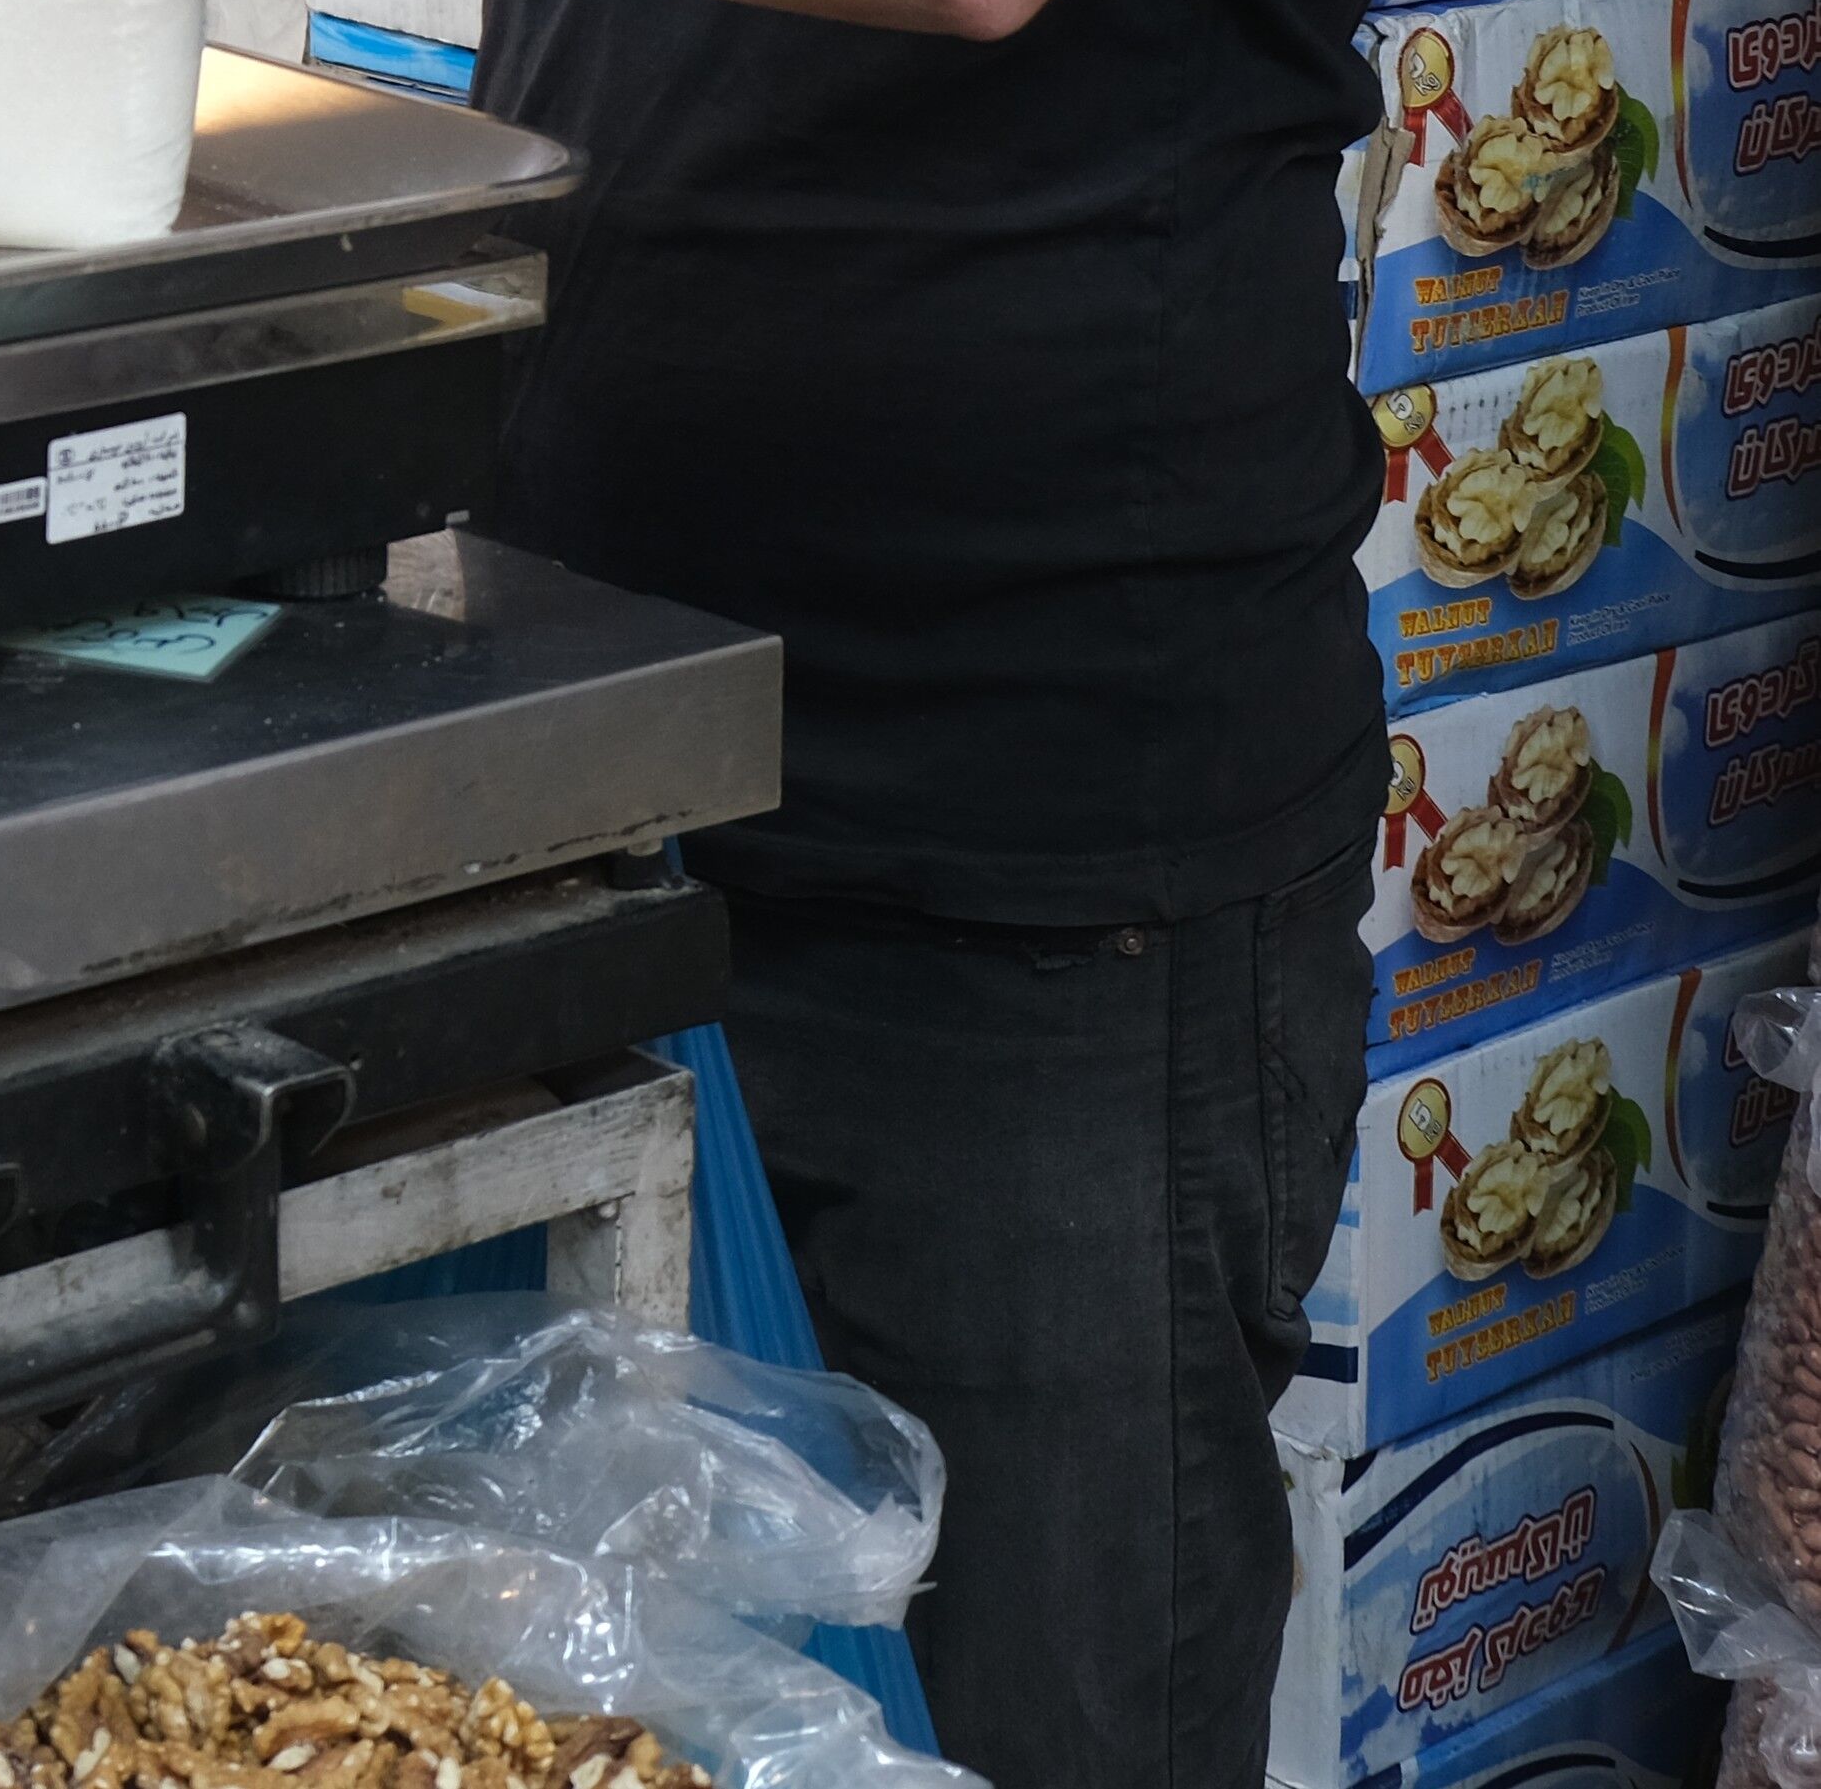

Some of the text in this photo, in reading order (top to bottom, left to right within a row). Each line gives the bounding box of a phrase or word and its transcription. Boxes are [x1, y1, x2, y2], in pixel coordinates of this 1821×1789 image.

[1413, 265, 1504, 306] WALNUT
[1385, 390, 1415, 423] 5
[1398, 597, 1492, 639] WALNUT
[1392, 948, 1477, 996] WALNUT
[1388, 960, 1543, 1041] TUYSERKAN
[1407, 1097, 1431, 1134] 5
[1426, 1284, 1507, 1337] WALNUT
[1424, 1291, 1577, 1387] TUYSERKAN
[1408, 1483, 1599, 1635] تویسرکان
[1477, 1565, 1607, 1702] گردوی
